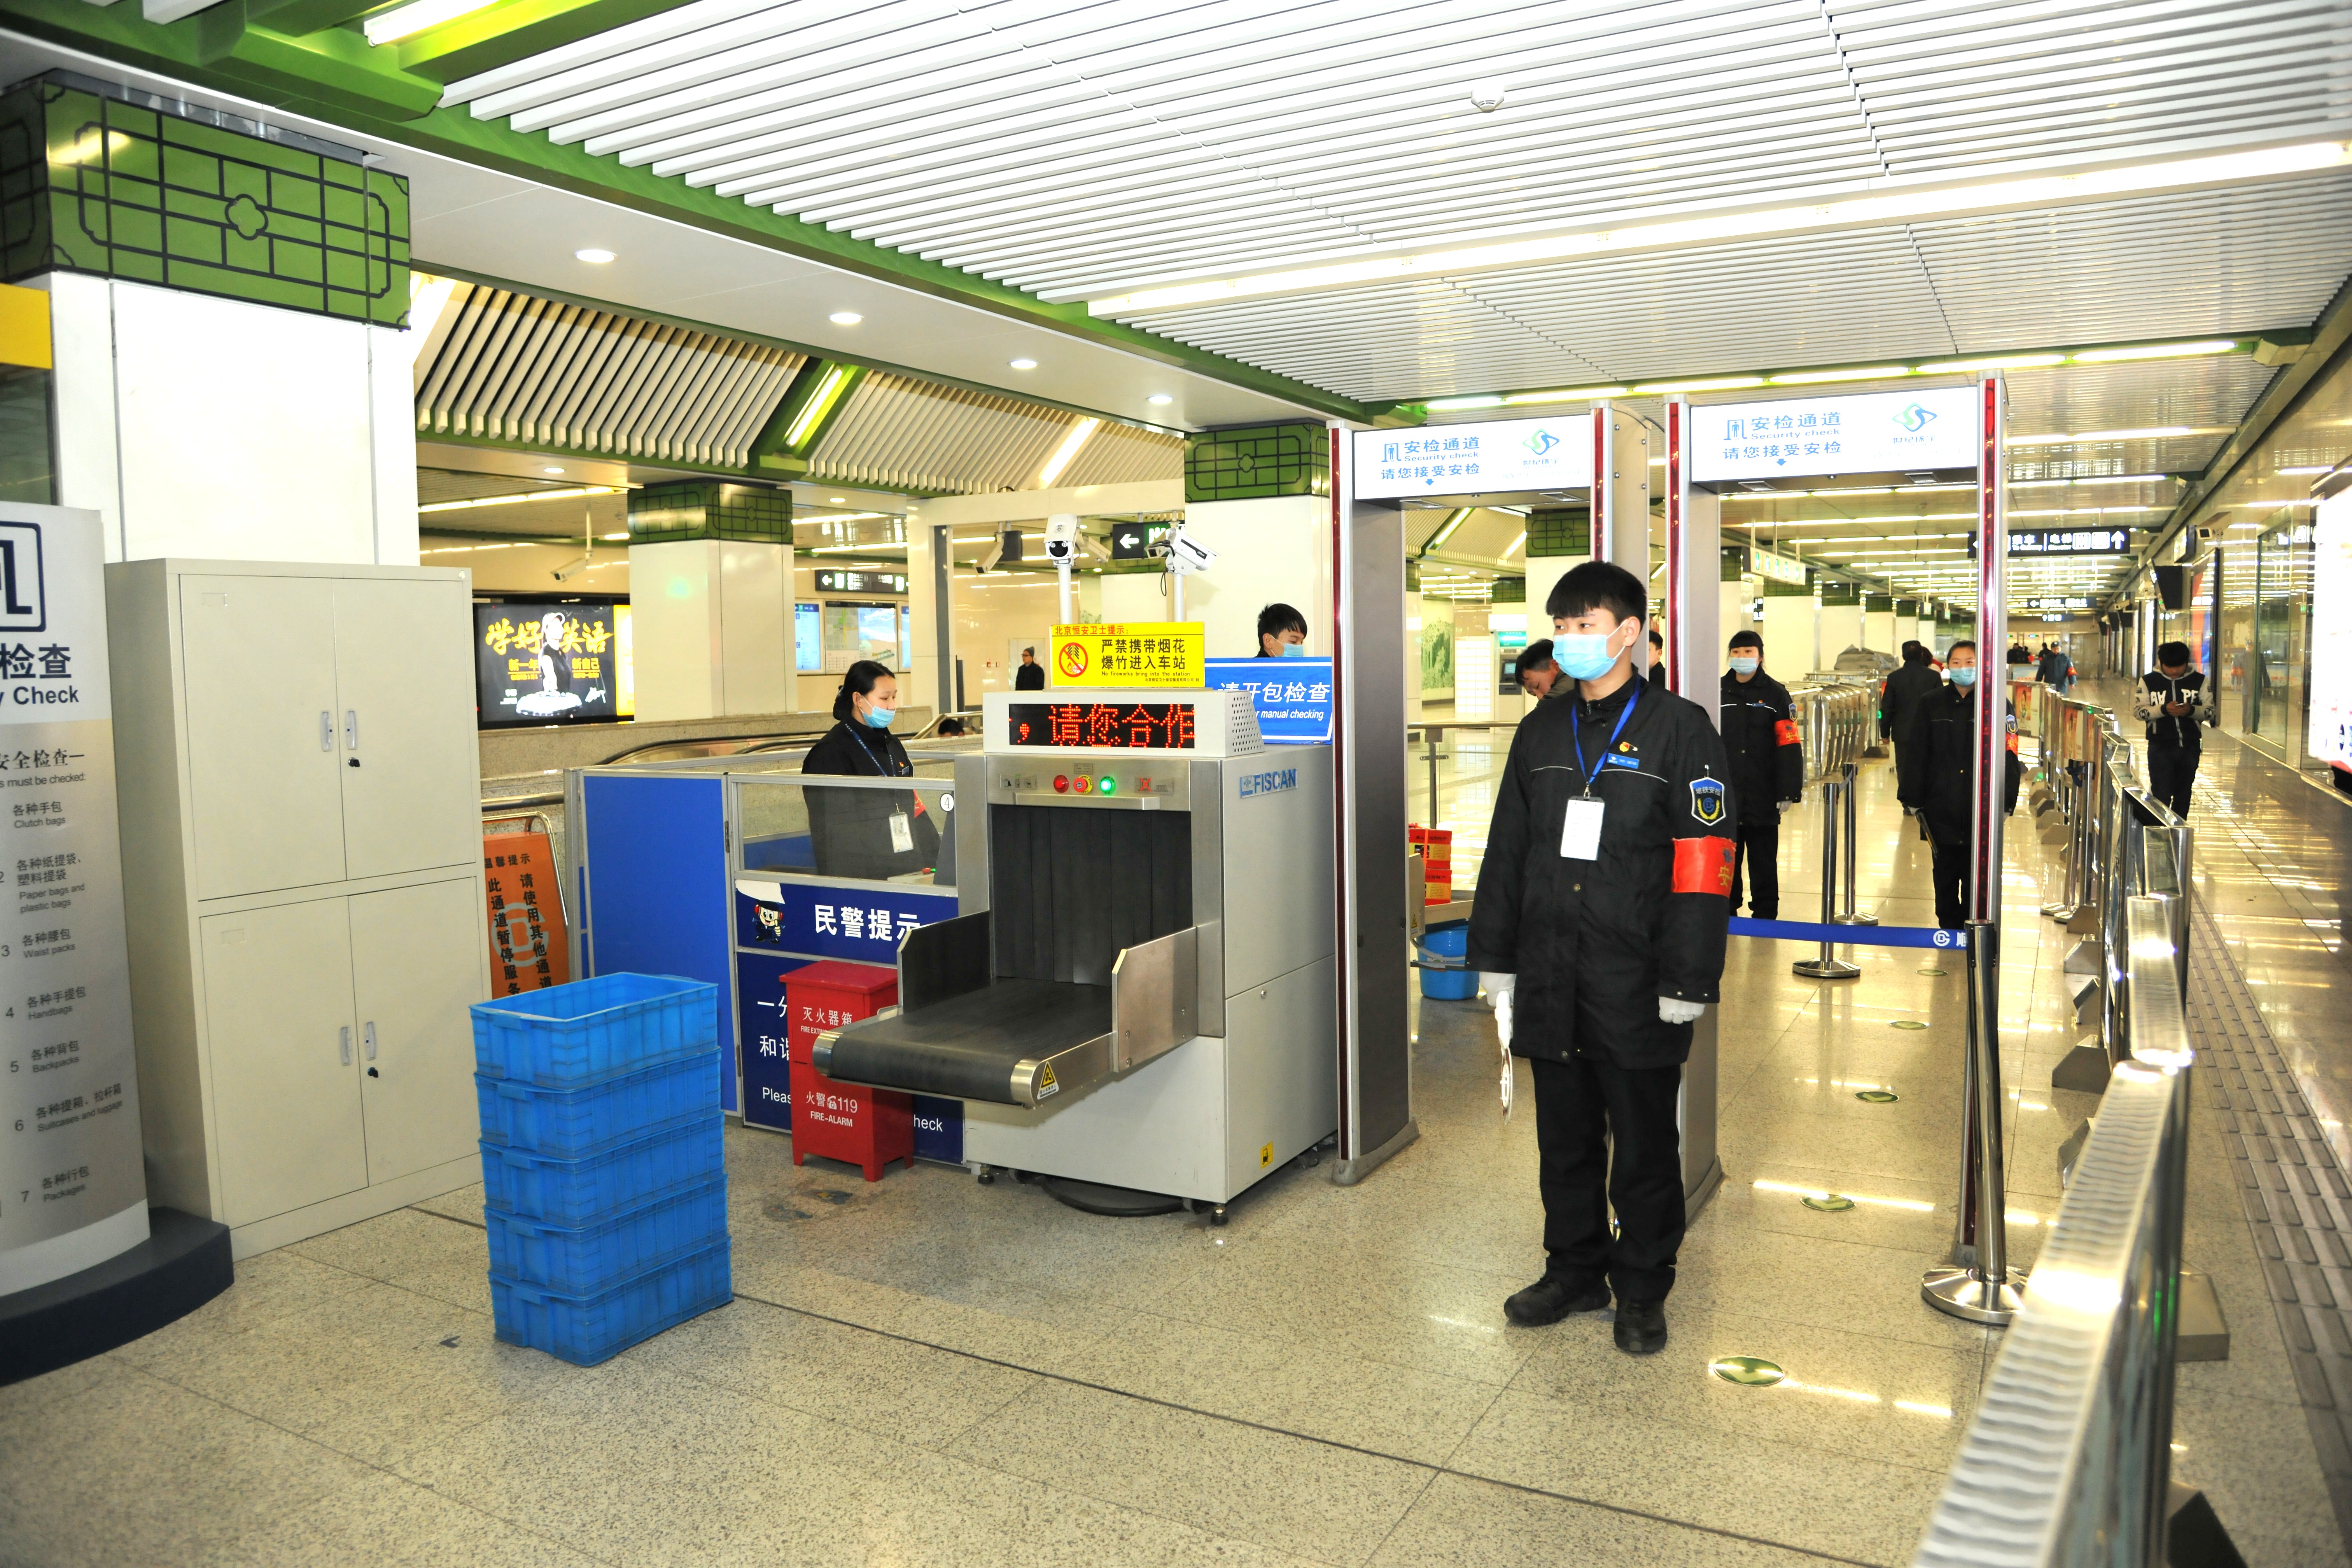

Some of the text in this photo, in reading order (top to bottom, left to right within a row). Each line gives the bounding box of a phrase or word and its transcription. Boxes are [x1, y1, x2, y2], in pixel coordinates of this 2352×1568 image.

[1751, 412, 1841, 431] 安检通道
[1752, 431, 1800, 439] Security
[1404, 436, 1479, 453] 安检通道
[1723, 441, 1841, 459] 请您接受安检
[1381, 463, 1479, 480] 请您接受安检
[485, 618, 614, 655] 学好 英语
[1101, 638, 1185, 654] 严禁携带烟花
[0, 643, 72, 680] 检查
[1101, 655, 1185, 670] 爆竹进入车站
[13, 685, 79, 705] Check
[1260, 709, 1289, 719] manual
[1290, 709, 1324, 721] checking
[7, 777, 33, 787] must
[35, 776, 47, 785] be
[1253, 768, 1297, 793] FISCAN
[1695, 786, 1721, 796] 地铁安检
[13, 801, 62, 816] 各种手包
[14, 817, 66, 828] Clutch bags
[485, 853, 530, 869] 温馨提示
[17, 868, 66, 886] 塑料提袋
[19, 883, 85, 899] Paper bags and
[20, 899, 72, 914] plastic bags
[815, 903, 920, 942] 民警提示
[22, 929, 71, 947] 各种腰包
[488, 877, 521, 996] 此通道暂停服务
[520, 873, 552, 989] 请使用其他通道
[1, 945, 10, 957] 3
[23, 943, 75, 958] Waist packs
[27, 986, 86, 1008] 各种手提包
[5, 1007, 14, 1018] 4
[28, 1006, 73, 1020] Handbags
[803, 1006, 853, 1026] 灭火器箱
[801, 1025, 810, 1033] FIRE
[31, 1040, 79, 1061] 各种背包
[10, 1060, 19, 1073] 5
[32, 1056, 80, 1073] Backpacks
[762, 1087, 791, 1104] Pleas
[806, 1091, 858, 1113] 火警 119
[15, 1119, 24, 1131] 6
[810, 1111, 853, 1127] FIRE-ALARM
[914, 1114, 943, 1132] heck
[21, 1190, 30, 1202] 7
